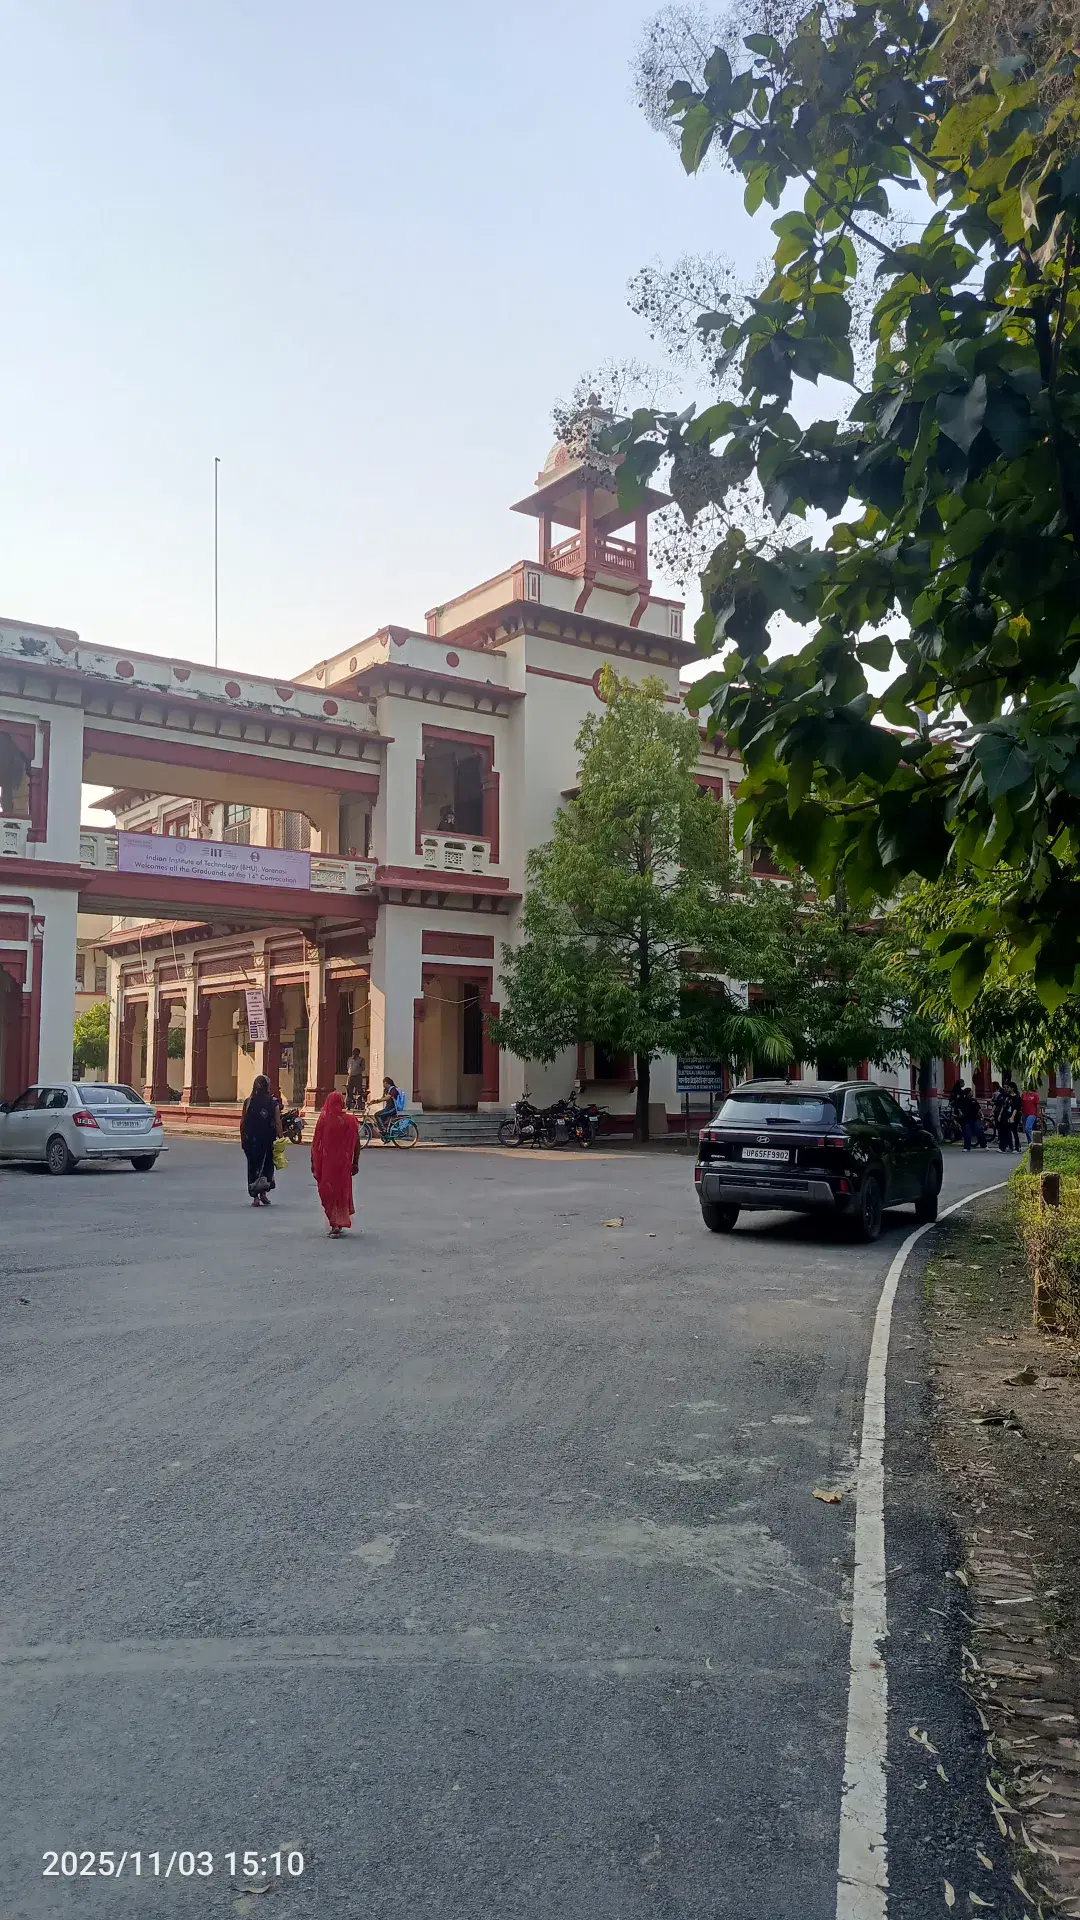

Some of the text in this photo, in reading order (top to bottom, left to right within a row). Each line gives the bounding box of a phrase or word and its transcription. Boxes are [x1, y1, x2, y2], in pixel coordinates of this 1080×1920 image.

[210, 848, 223, 858] IIT
[146, 854, 167, 862] Indian
[168, 856, 194, 865] Institute
[204, 860, 239, 871] Technology
[134, 861, 168, 871] Welcomes
[169, 864, 178, 872] all
[179, 865, 190, 873] the
[191, 867, 227, 877] Graduands
[260, 874, 297, 884] Convocation
[746, 1149, 789, 1160] UP65FF9902
